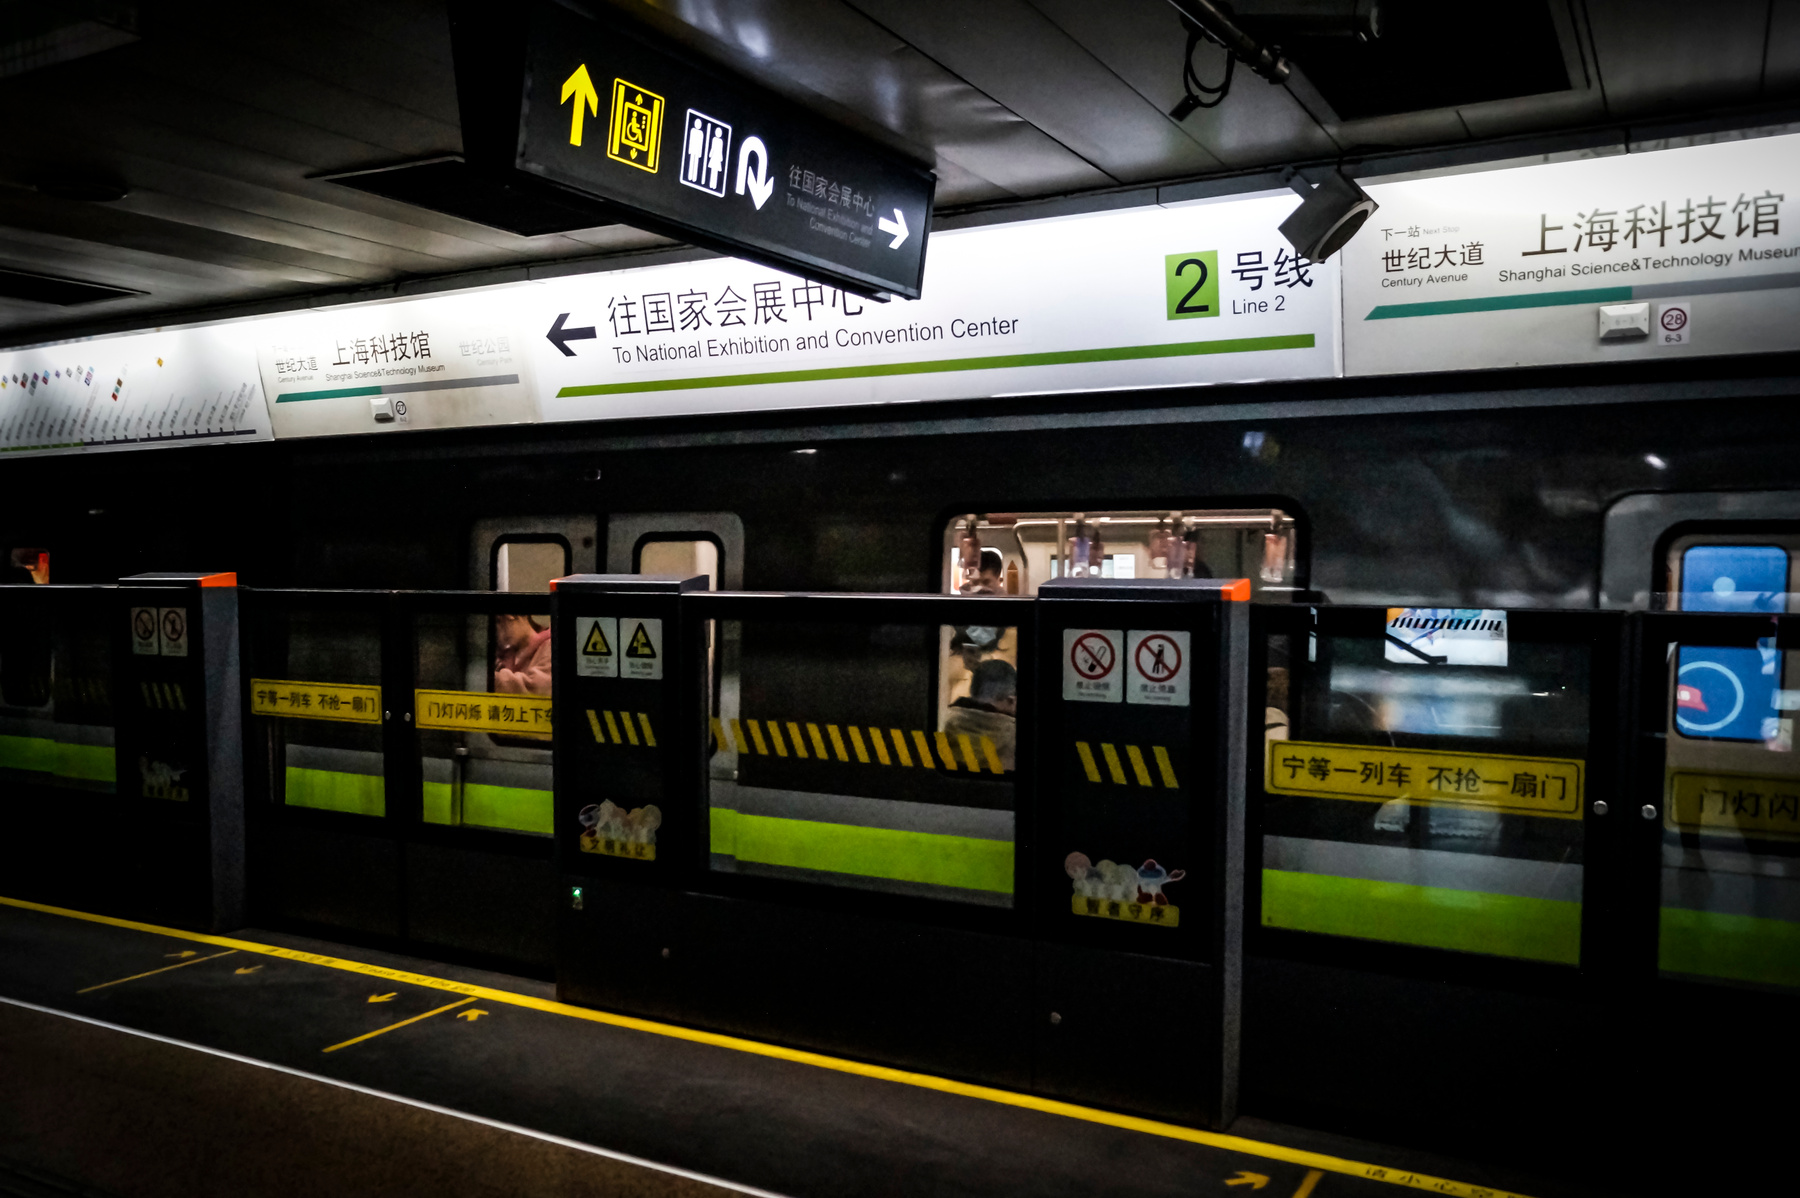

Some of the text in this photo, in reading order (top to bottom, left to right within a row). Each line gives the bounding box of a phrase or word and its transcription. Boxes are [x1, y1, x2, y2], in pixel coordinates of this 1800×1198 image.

[788, 165, 874, 217] 往国家会展中心
[786, 192, 795, 206] To
[796, 197, 826, 217] National
[810, 217, 848, 241] Convention
[1380, 225, 1460, 241] 下一站 Next Stop
[1521, 190, 1785, 257] 上海科技馆
[1381, 241, 1484, 273] 世纪大道
[1498, 264, 1566, 282] Shanghai
[1571, 253, 1733, 276] Science&Technology
[1175, 247, 1313, 314] 2 号线
[1381, 272, 1468, 288] Century Avenue
[1232, 295, 1285, 315] Line 2
[1666, 312, 1683, 326] 28
[332, 330, 431, 366] 上海科技馆
[459, 336, 511, 357] 世纪公园
[612, 317, 1019, 364] To National Exhibition and Convention Center
[275, 356, 318, 374] 世纪大道
[325, 373, 353, 382] Shanghai
[417, 364, 446, 373] Museum
[427, 701, 482, 721] 门灯闪烁
[1282, 755, 1568, 801] 宁等一列车 不抢一扇门
